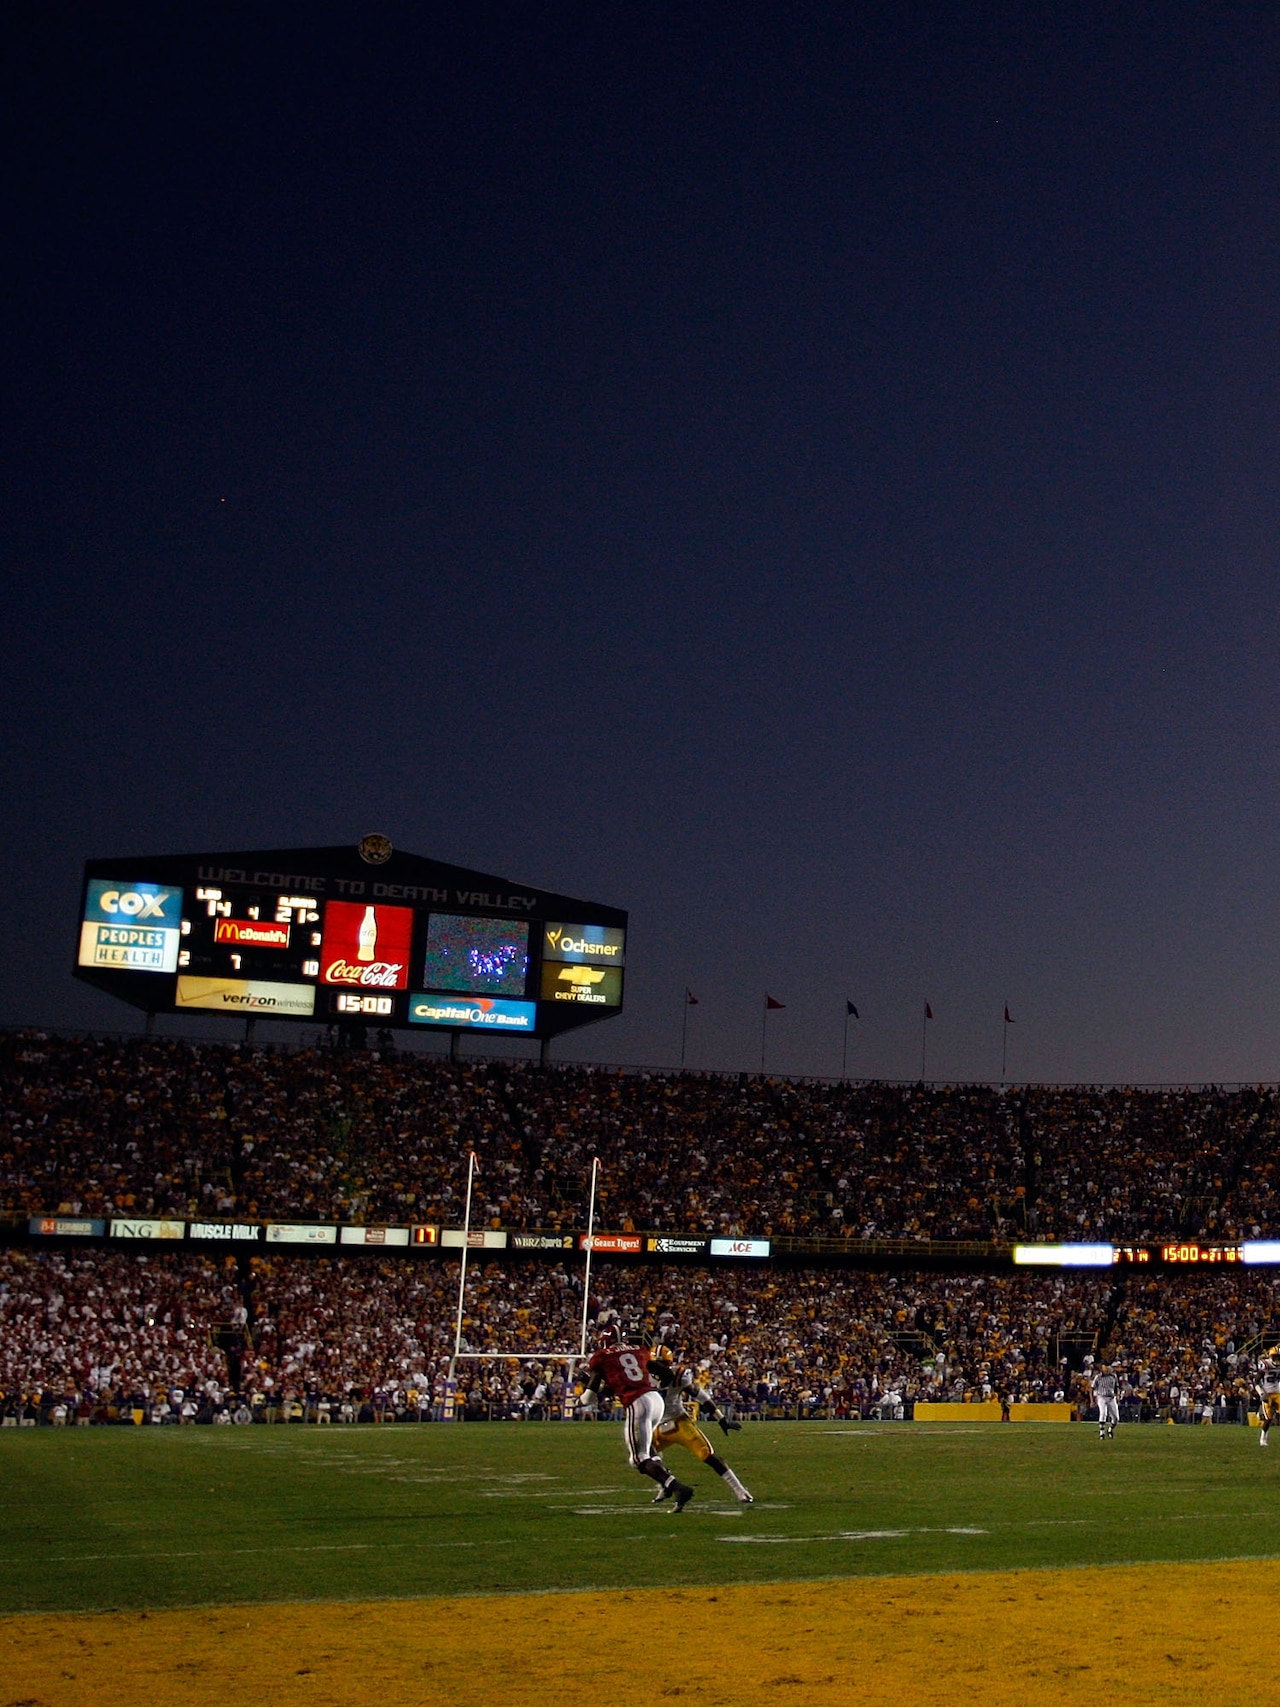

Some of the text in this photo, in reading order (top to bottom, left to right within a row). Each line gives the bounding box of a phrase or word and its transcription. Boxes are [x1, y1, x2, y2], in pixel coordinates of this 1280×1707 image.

[198, 866, 537, 911] WELCOME TO DEATH VALLEY
[100, 890, 170, 919] COX
[207, 900, 232, 917] 14
[248, 906, 260, 920] 4
[274, 906, 307, 924] 21
[101, 928, 164, 945] PEOPLES
[218, 923, 286, 943] McDonald's
[560, 938, 618, 956] Ochsner
[99, 948, 160, 964] HEALTH
[179, 950, 191, 966] 2
[231, 954, 242, 970] 7
[302, 960, 320, 976] 10
[325, 960, 403, 987] Coca-Cola
[554, 991, 606, 1003] CHEVY DEALERS
[571, 986, 592, 995] SUPER
[223, 993, 277, 1009] verizon
[338, 995, 393, 1014] 15:00
[498, 1013, 529, 1025] Bank
[113, 1223, 153, 1238] ING
[190, 1223, 259, 1240] MUSCLE MILK
[418, 1227, 436, 1243] 17
[515, 1236, 573, 1249] WBRZ Sports 2
[595, 1238, 640, 1250] Geaux Tigers!
[730, 1241, 753, 1253] ACE
[1163, 1247, 1199, 1261] 15:00
[619, 1353, 644, 1381] 8
